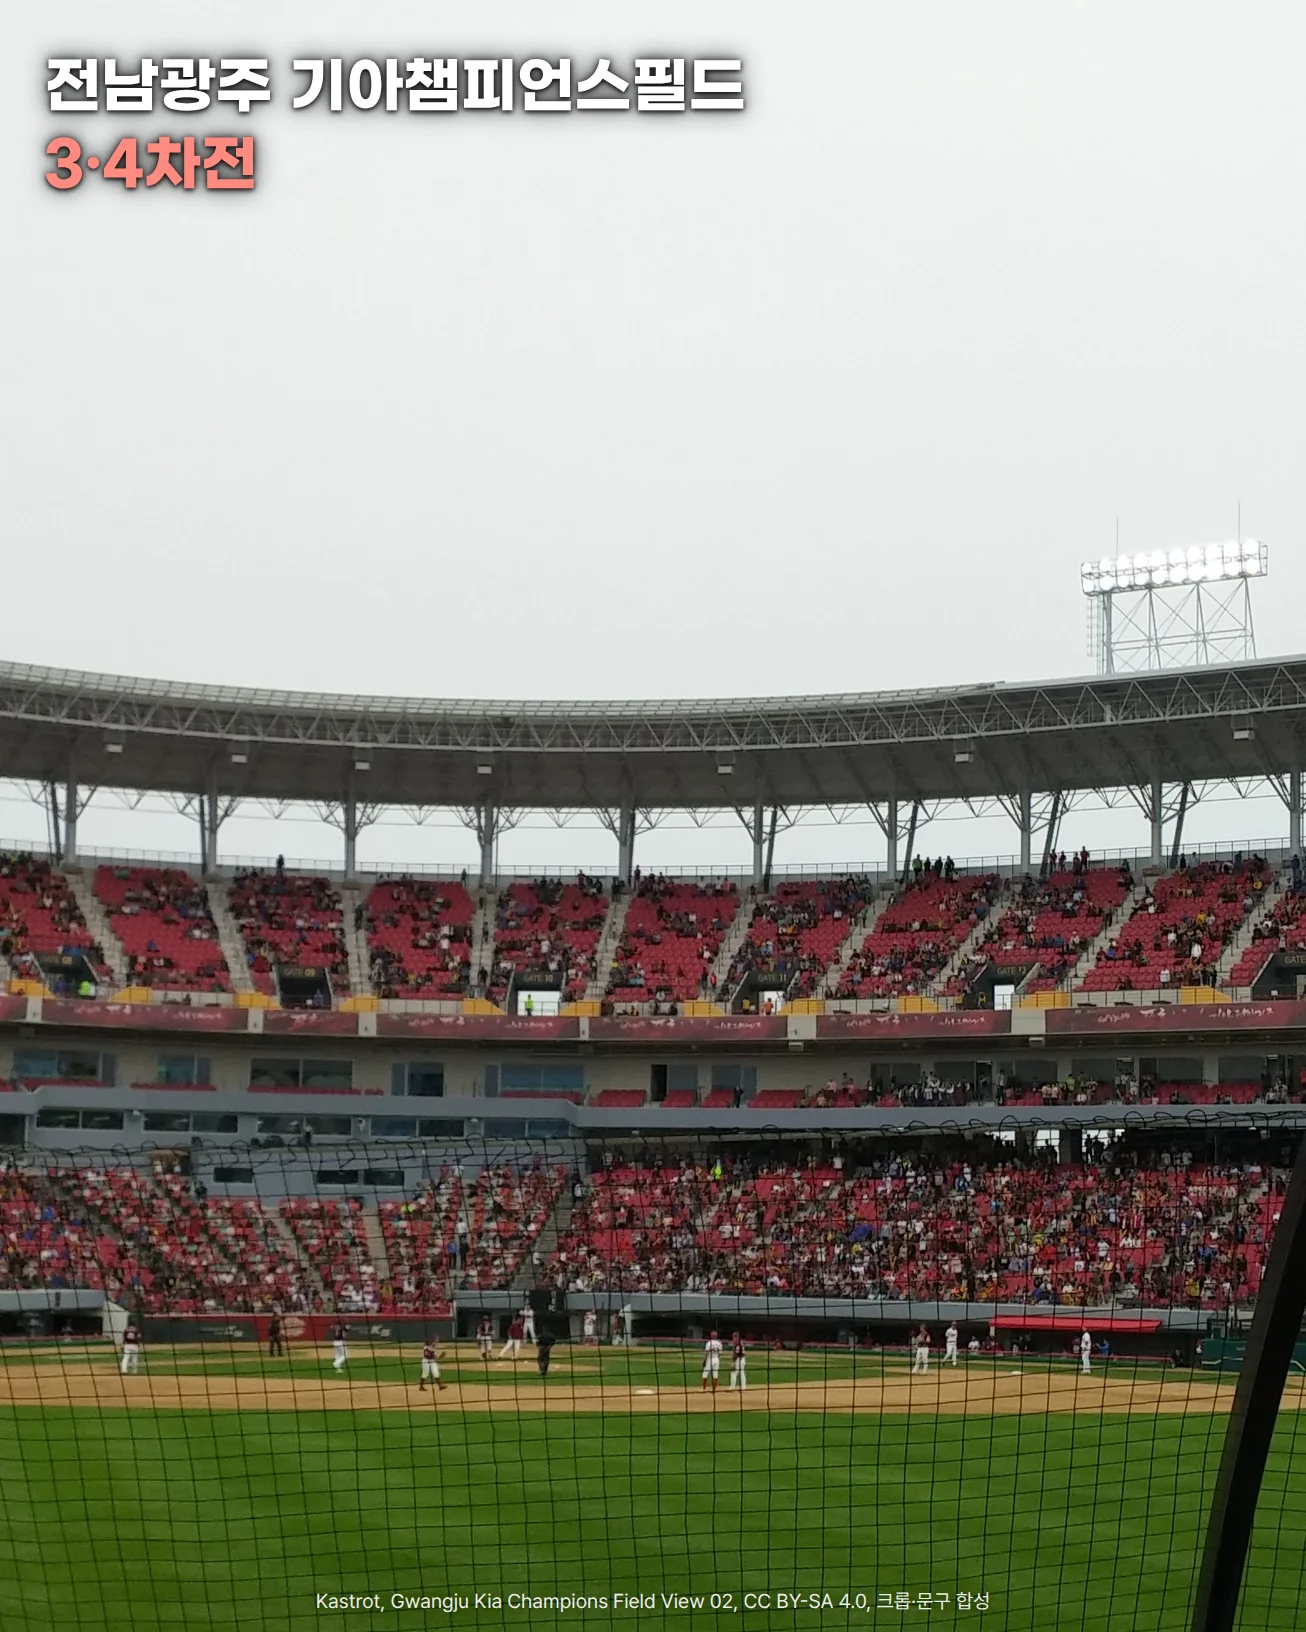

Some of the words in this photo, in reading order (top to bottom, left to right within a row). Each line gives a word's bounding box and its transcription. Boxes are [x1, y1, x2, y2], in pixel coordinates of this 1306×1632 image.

[997, 966, 1016, 975] GATE
[523, 974, 541, 983] GATE
[757, 973, 777, 983] GATE
